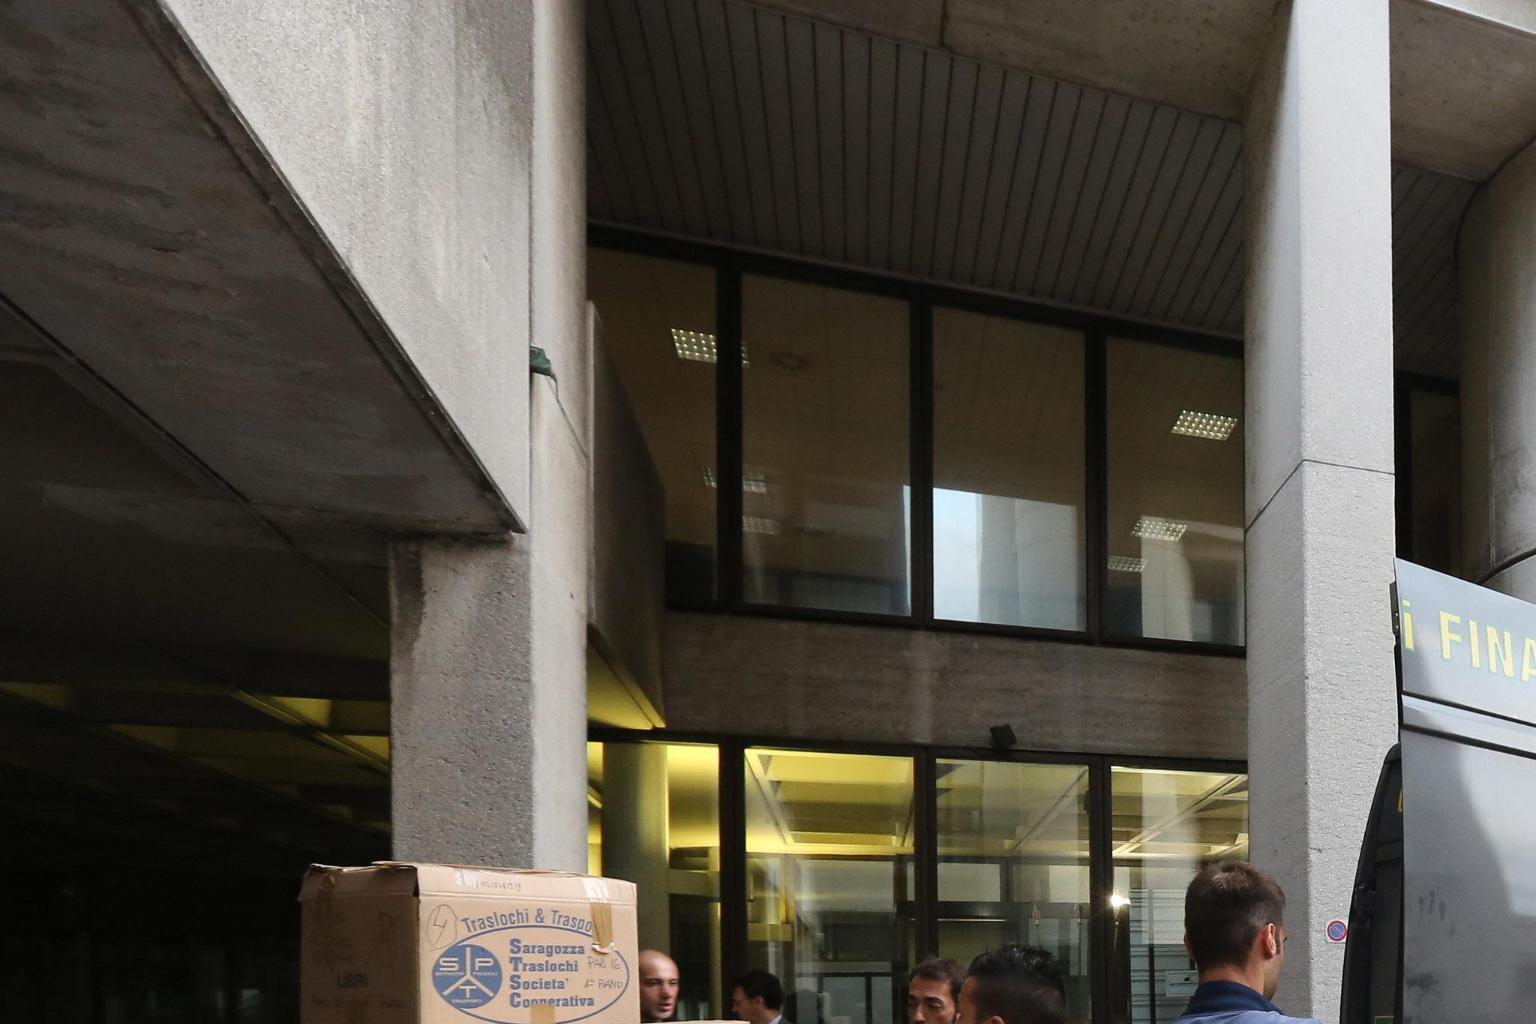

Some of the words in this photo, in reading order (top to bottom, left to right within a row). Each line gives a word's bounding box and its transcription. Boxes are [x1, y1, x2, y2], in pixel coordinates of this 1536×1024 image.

[461, 907, 529, 933] Traslochi
[535, 910, 545, 924] &
[552, 909, 593, 933] Traspo
[509, 938, 585, 957] Saragozza
[509, 956, 578, 972] Traslochi
[509, 974, 569, 991] Societa'
[509, 992, 595, 1009] Cooperativa
